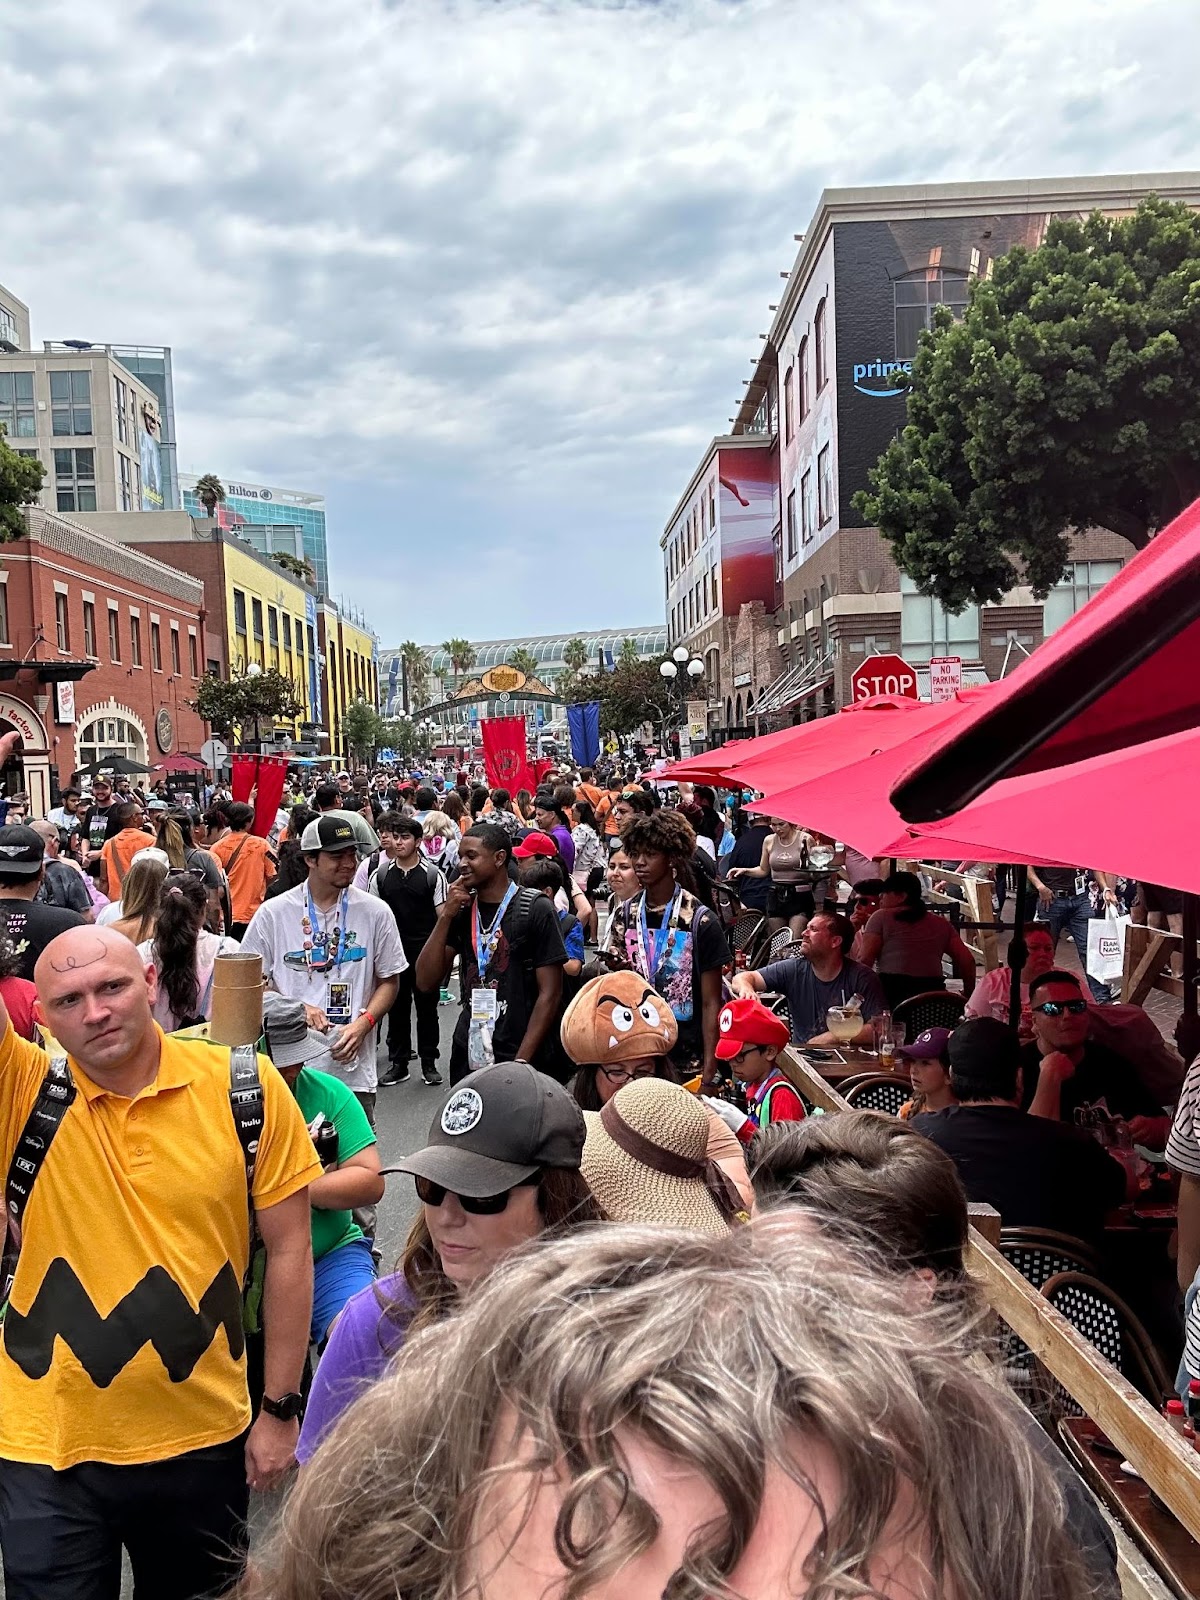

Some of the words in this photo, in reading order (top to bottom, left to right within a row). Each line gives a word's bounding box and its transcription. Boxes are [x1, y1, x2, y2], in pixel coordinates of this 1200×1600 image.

[853, 358, 913, 383] prime
[228, 485, 258, 498] Hilton
[940, 665, 951, 675] NO
[932, 675, 960, 685] PARKING
[856, 675, 914, 701] STOP
[8, 709, 35, 740] factory
[241, 1118, 261, 1129] hulu
[10, 1180, 26, 1195] hulu
